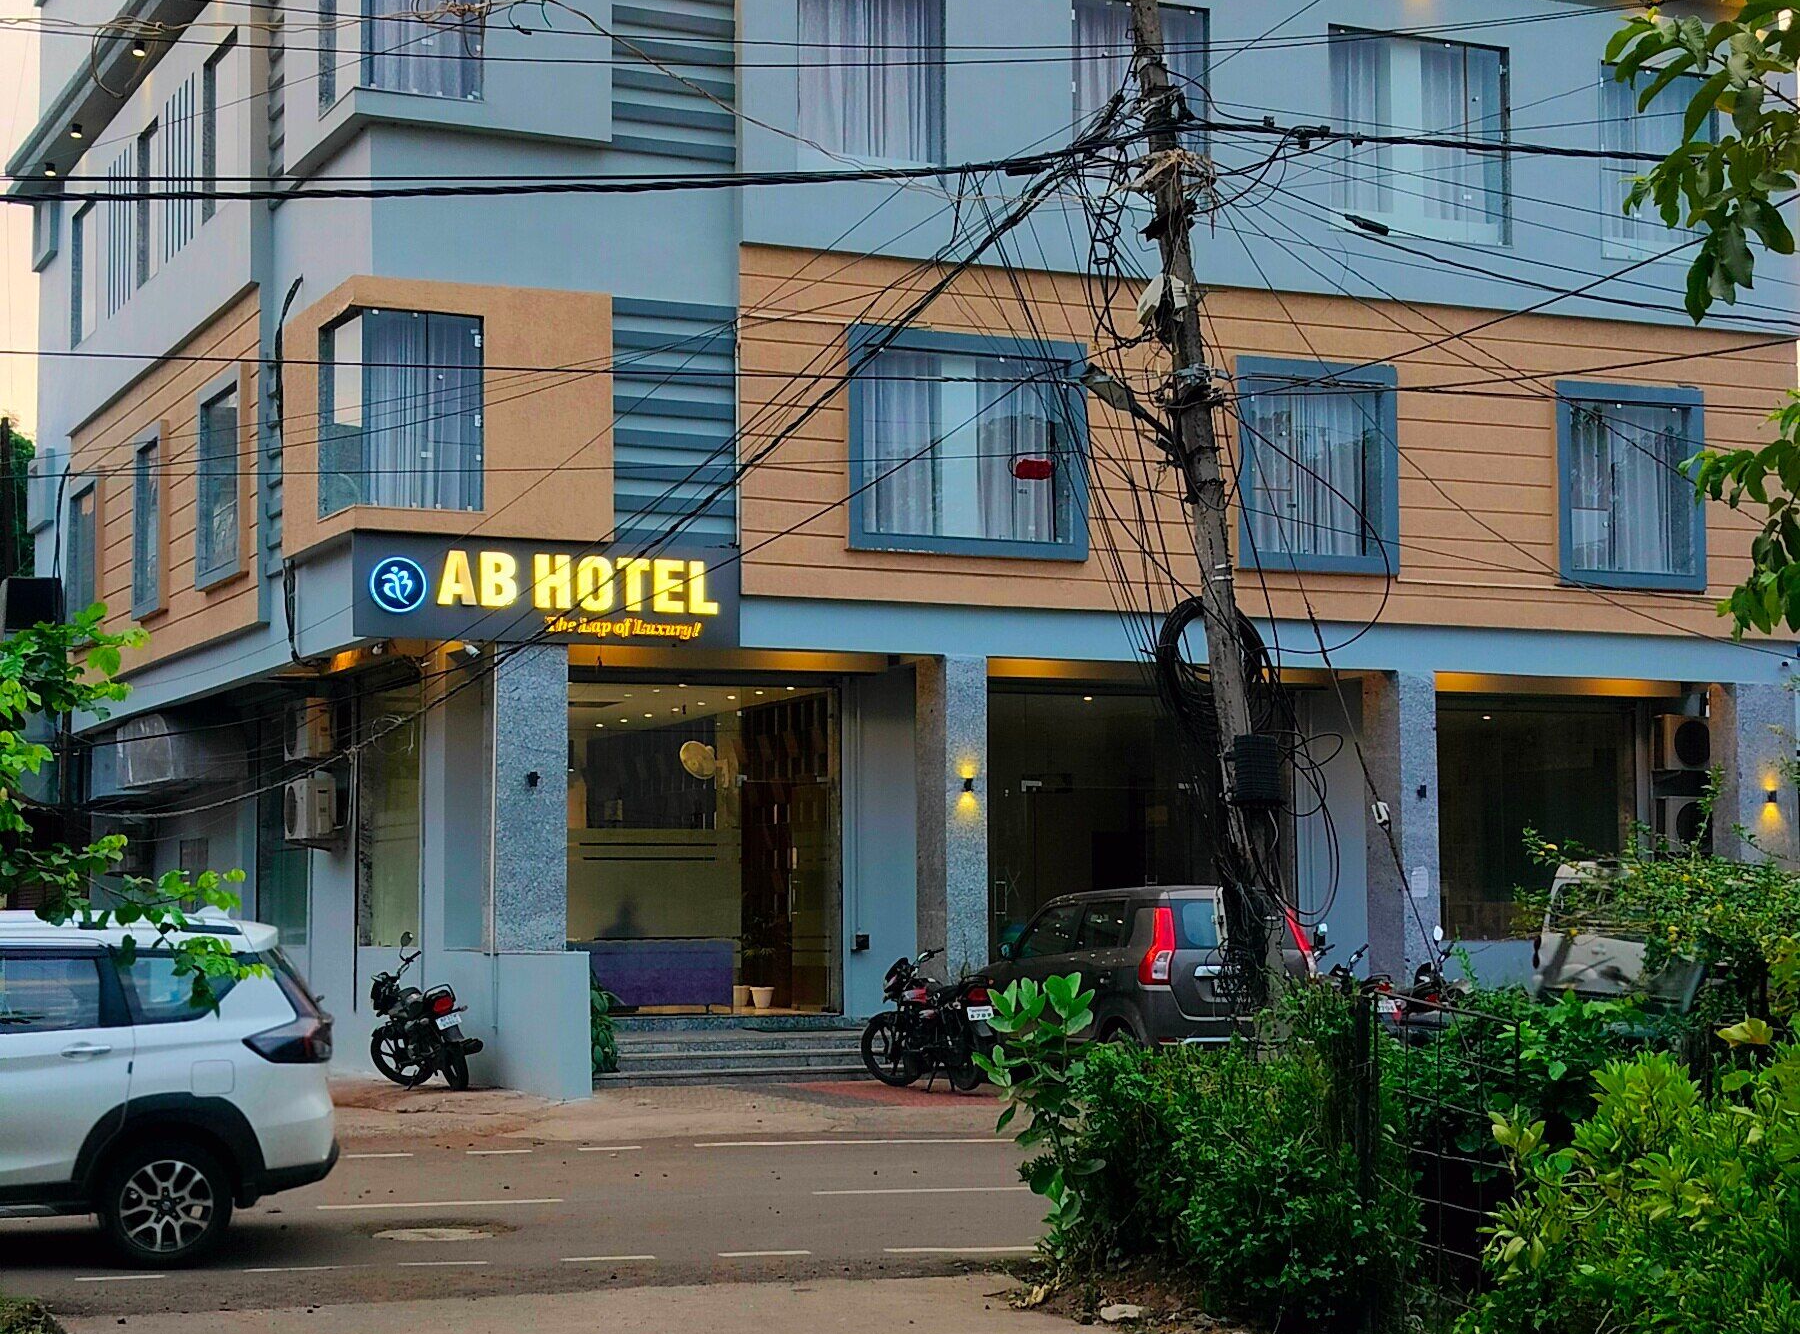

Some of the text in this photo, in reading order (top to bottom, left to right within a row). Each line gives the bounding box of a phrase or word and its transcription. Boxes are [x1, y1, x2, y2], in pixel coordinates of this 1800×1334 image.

[437, 550, 719, 615] AB HOTEL
[545, 616, 702, 640] The Lap of Luxury!
